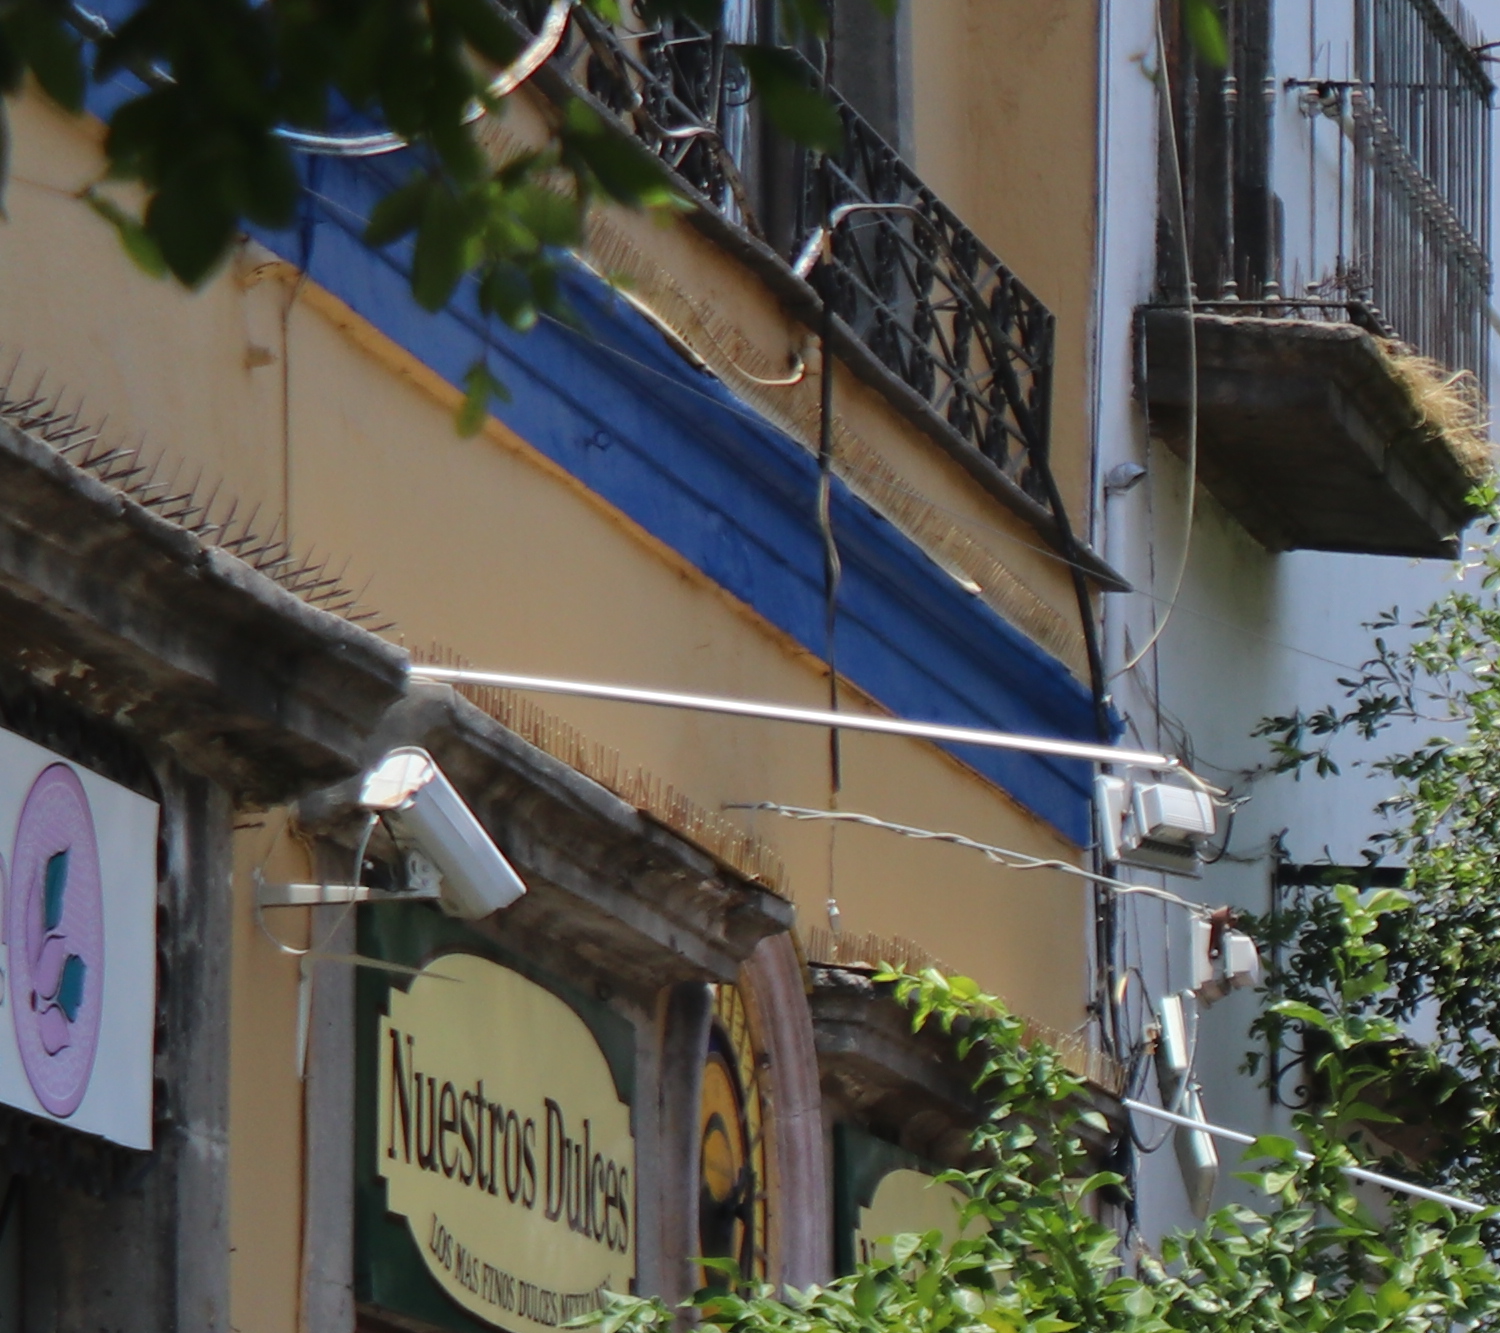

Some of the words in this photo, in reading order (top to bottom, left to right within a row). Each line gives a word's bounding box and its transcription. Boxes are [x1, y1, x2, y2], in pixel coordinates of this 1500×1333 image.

[388, 1028, 536, 1211] Nuestros
[544, 1097, 630, 1254] Dulces
[429, 1212, 453, 1272] LOS
[455, 1243, 480, 1294] MAS
[482, 1264, 515, 1312] FINOS
[519, 1279, 557, 1326] DULCES
